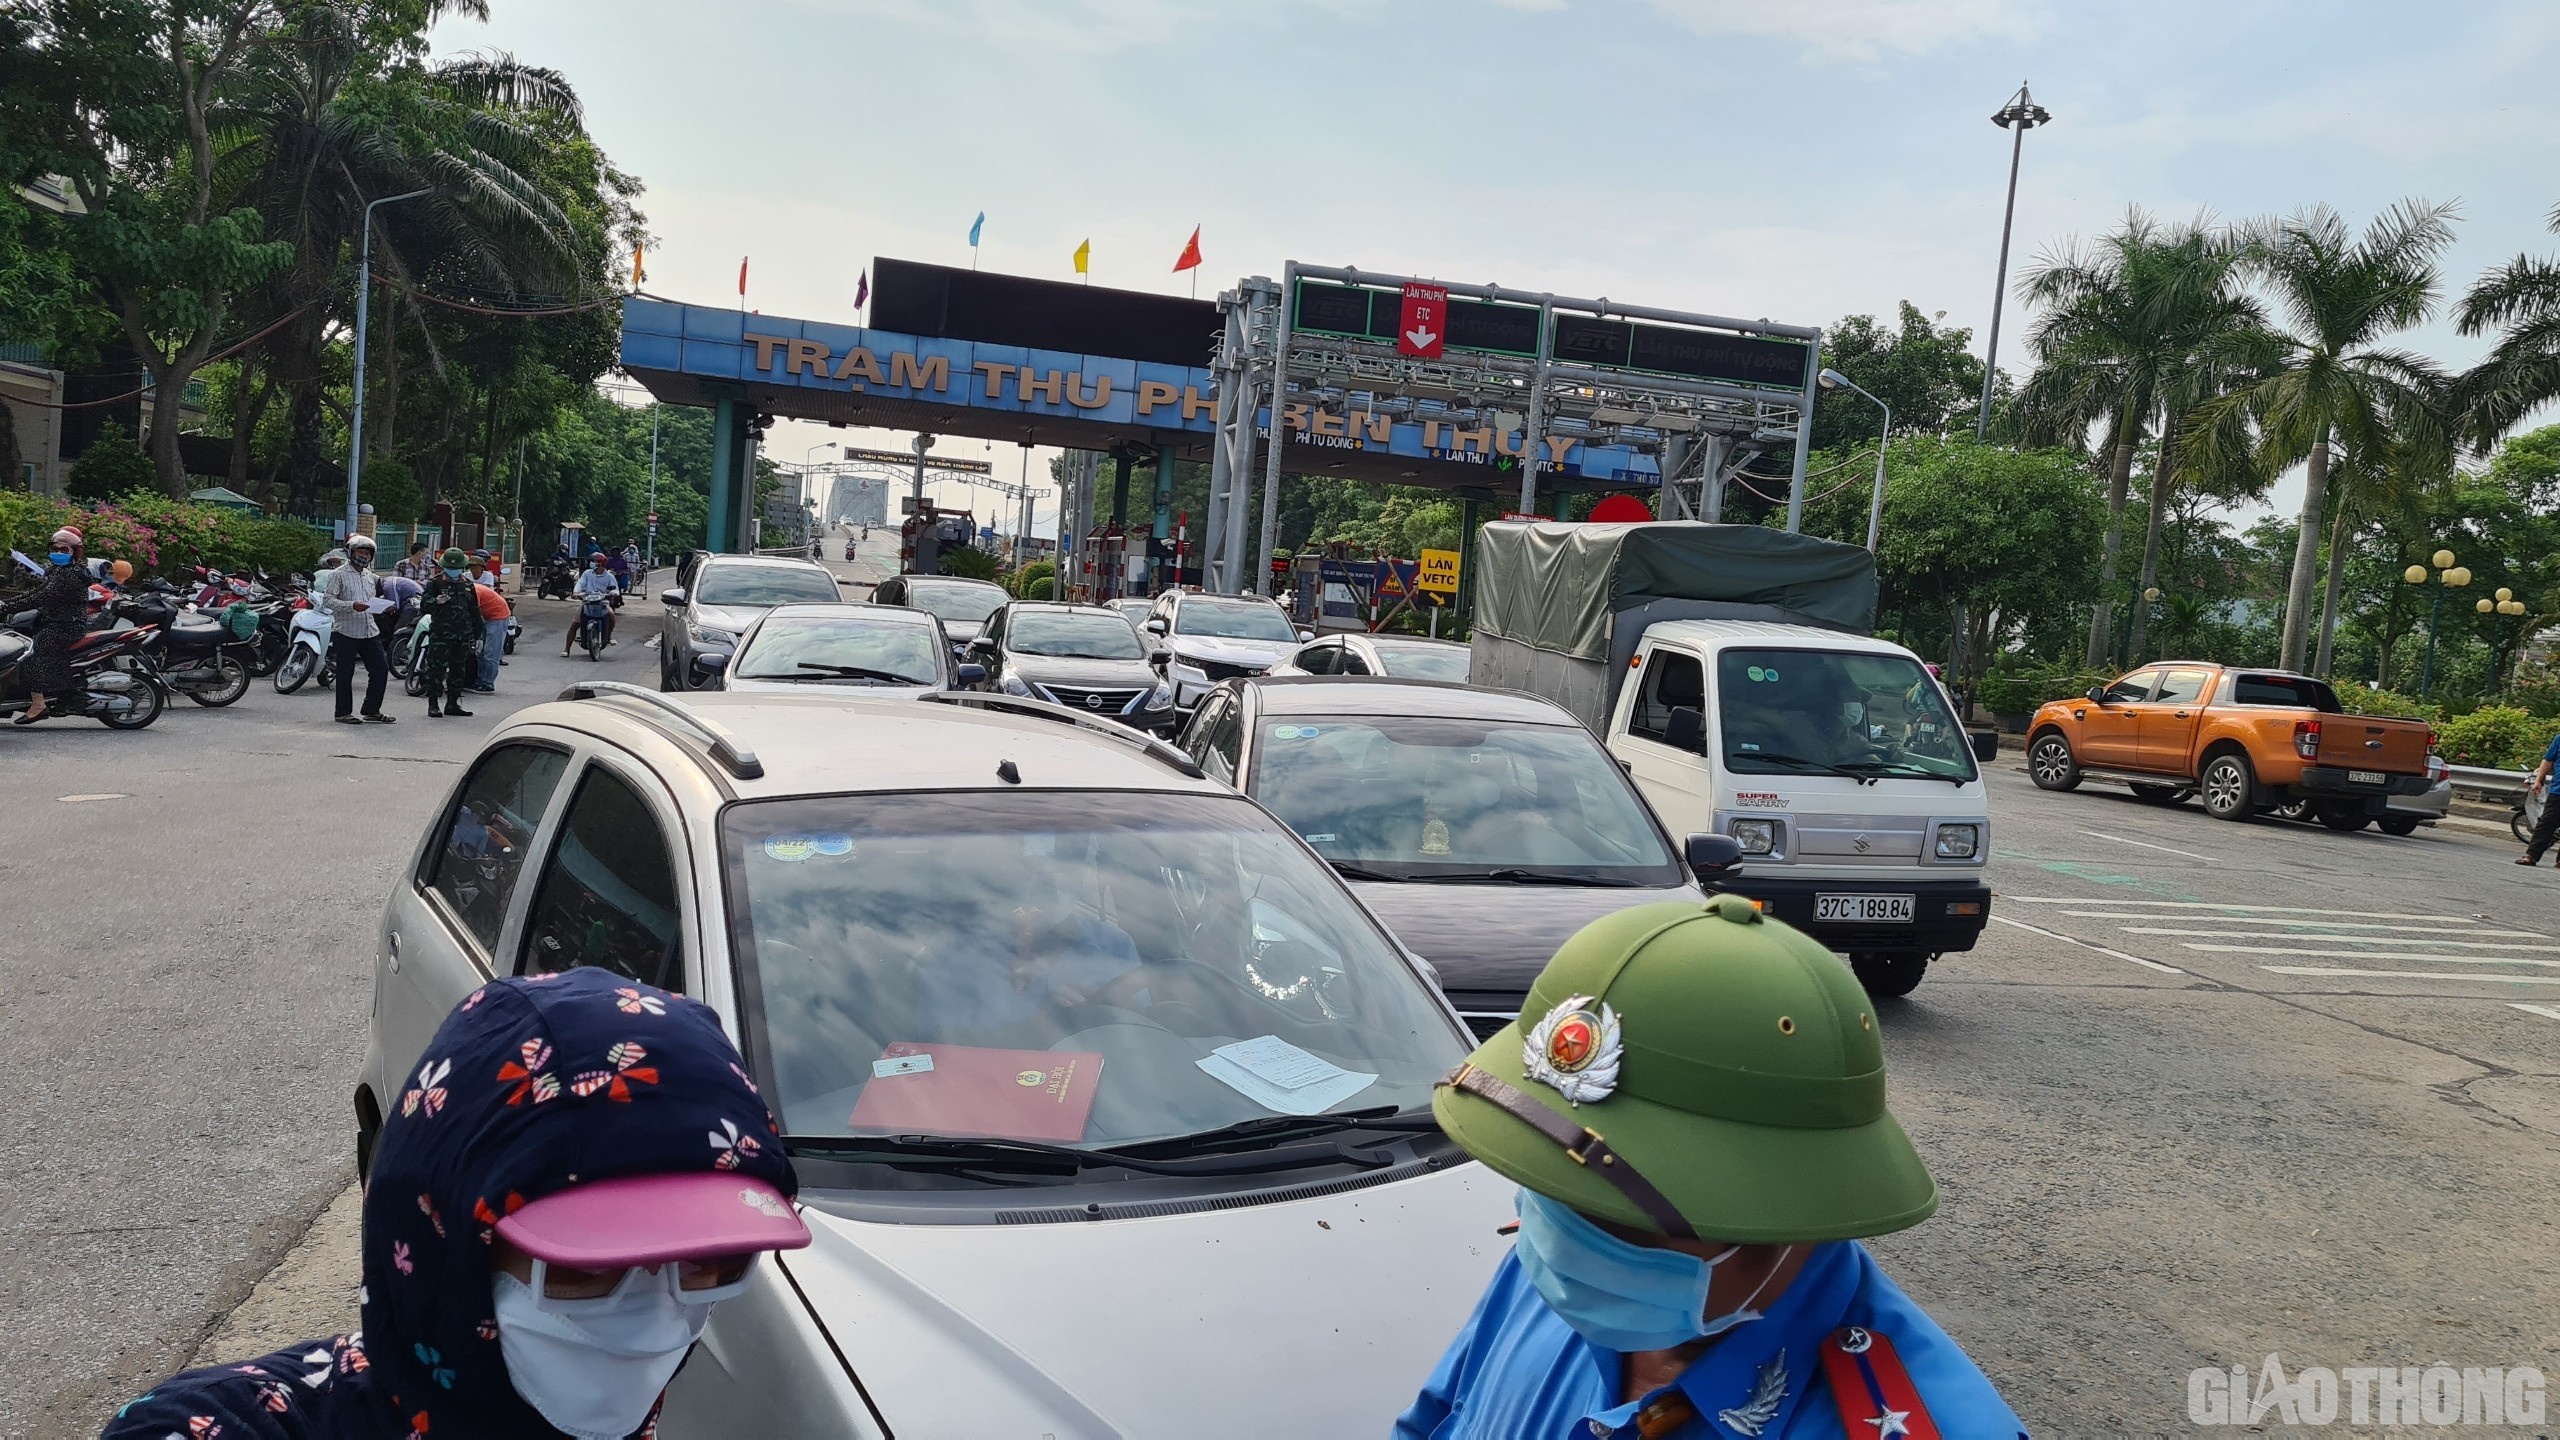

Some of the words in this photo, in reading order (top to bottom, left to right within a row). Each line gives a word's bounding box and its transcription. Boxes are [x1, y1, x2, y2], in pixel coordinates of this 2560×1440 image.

[1406, 286, 1420, 298] LÀN
[1420, 288, 1433, 300] THU
[1433, 290, 1446, 302] PHÍ
[1416, 307, 1431, 320] ETC
[744, 332, 949, 392] TRẠM
[974, 361, 1111, 408] THU
[1138, 381, 1218, 422] PH
[1295, 431, 1310, 444] PHÍ
[1466, 451, 1485, 464] THU
[1427, 556, 1453, 571] LÀN
[1423, 573, 1456, 586] VETC
[1736, 792, 1778, 800] SUPER
[1736, 799, 1790, 808] CARRY
[775, 839, 806, 847] 04/22
[1818, 897, 1910, 920] 37C-189.84
